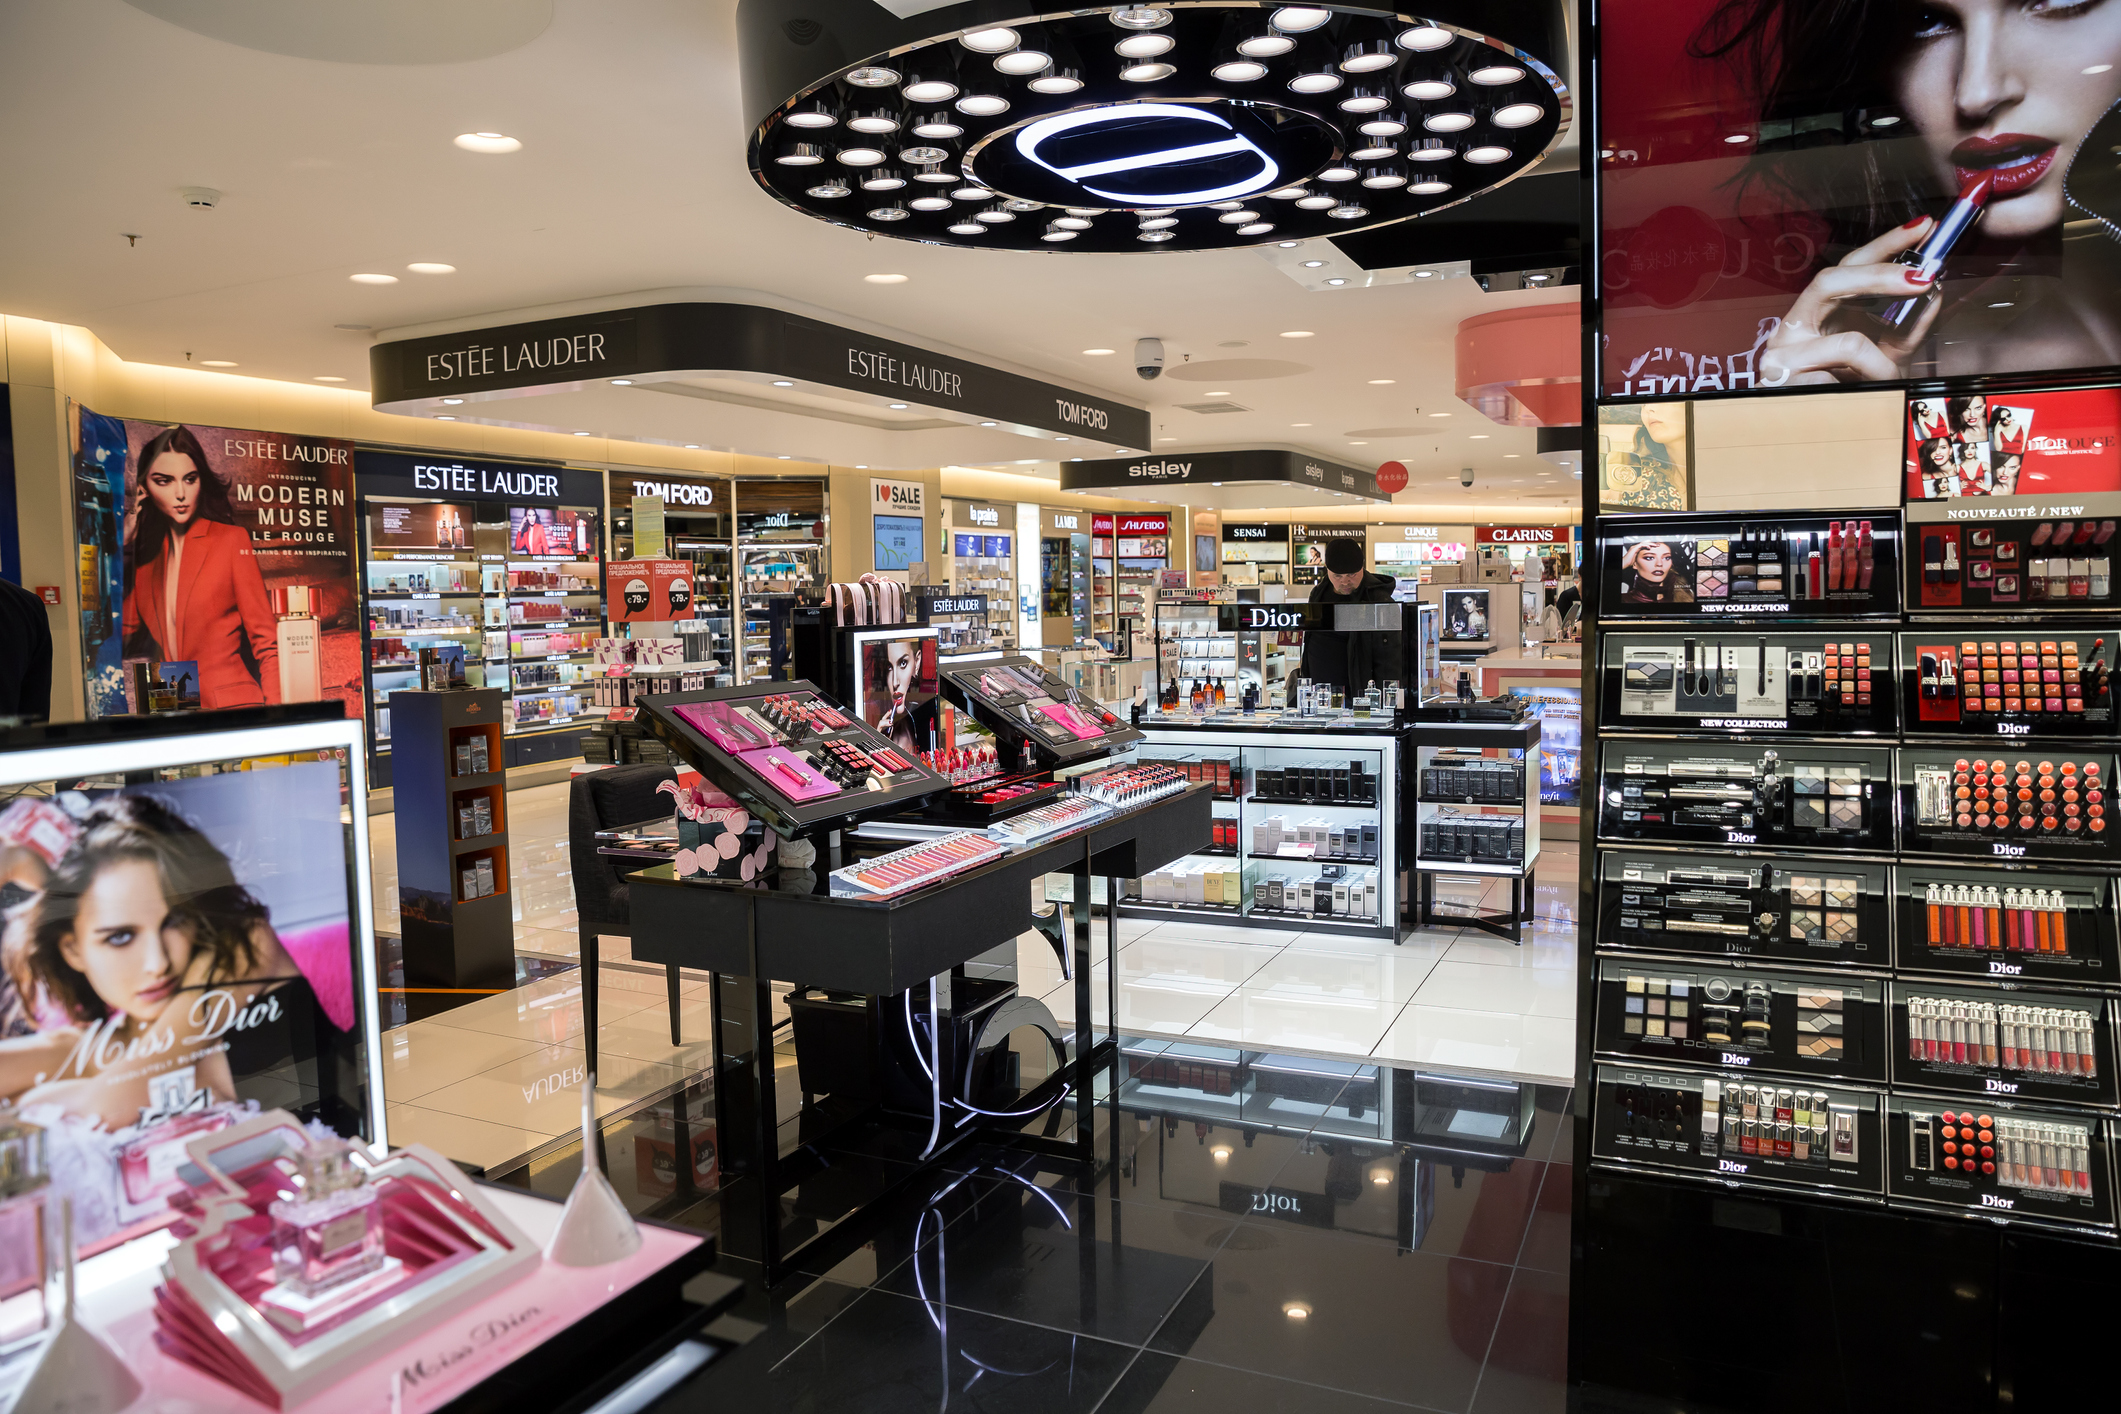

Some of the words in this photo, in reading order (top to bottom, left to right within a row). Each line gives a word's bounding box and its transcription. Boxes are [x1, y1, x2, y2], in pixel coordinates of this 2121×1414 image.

[504, 333, 605, 372] LAUDER
[902, 361, 962, 398] LAUDER
[1056, 399, 1080, 423] TOM
[1081, 406, 1108, 431] FORD
[282, 444, 348, 465] LAUDER
[1129, 461, 1192, 478] sisley
[1305, 462, 1324, 482] sisley
[268, 473, 317, 482] INTRODUCING
[482, 470, 559, 497] LAUDER
[237, 484, 345, 506] MODERN
[633, 481, 669, 504] TOM
[670, 484, 713, 506] FORD
[876, 484, 880, 502] I
[892, 486, 920, 505] SALE
[258, 508, 328, 527] MUSE
[969, 504, 977, 521] la
[977, 508, 999, 525] prairie
[1947, 506, 2036, 519] NOUVEAUTÉ
[2050, 506, 2084, 516] NEW
[1121, 520, 1165, 531] SHISEIDO
[1293, 525, 1305, 535] HR
[252, 531, 271, 541] LE
[282, 531, 335, 543] ROUGE
[1234, 528, 1266, 537] SENSAI
[1404, 527, 1438, 537] CLINIQUE
[1492, 529, 1554, 541] CLARINS
[954, 599, 980, 611] LAUDER
[1701, 604, 1724, 612] NEW
[1725, 603, 1789, 612] COLLECTION
[1250, 608, 1302, 627] Dior
[1166, 648, 1177, 657] SALE
[1700, 719, 1722, 727] NEW
[1724, 720, 1787, 729] COLLECTION
[1997, 723, 2030, 734] Dior
[1540, 791, 1560, 801] nefit
[1727, 832, 1757, 843] Dior
[1993, 844, 2025, 856] Dior
[1726, 942, 1752, 953] Dior
[1989, 962, 2022, 974] Dior
[34, 1011, 175, 1088] Miss
[182, 989, 283, 1045] Dior
[1722, 1053, 1750, 1065] Dior
[1985, 1080, 2018, 1093] Dior
[1719, 1160, 1748, 1173] Dior
[1981, 1194, 2014, 1209] Dior
